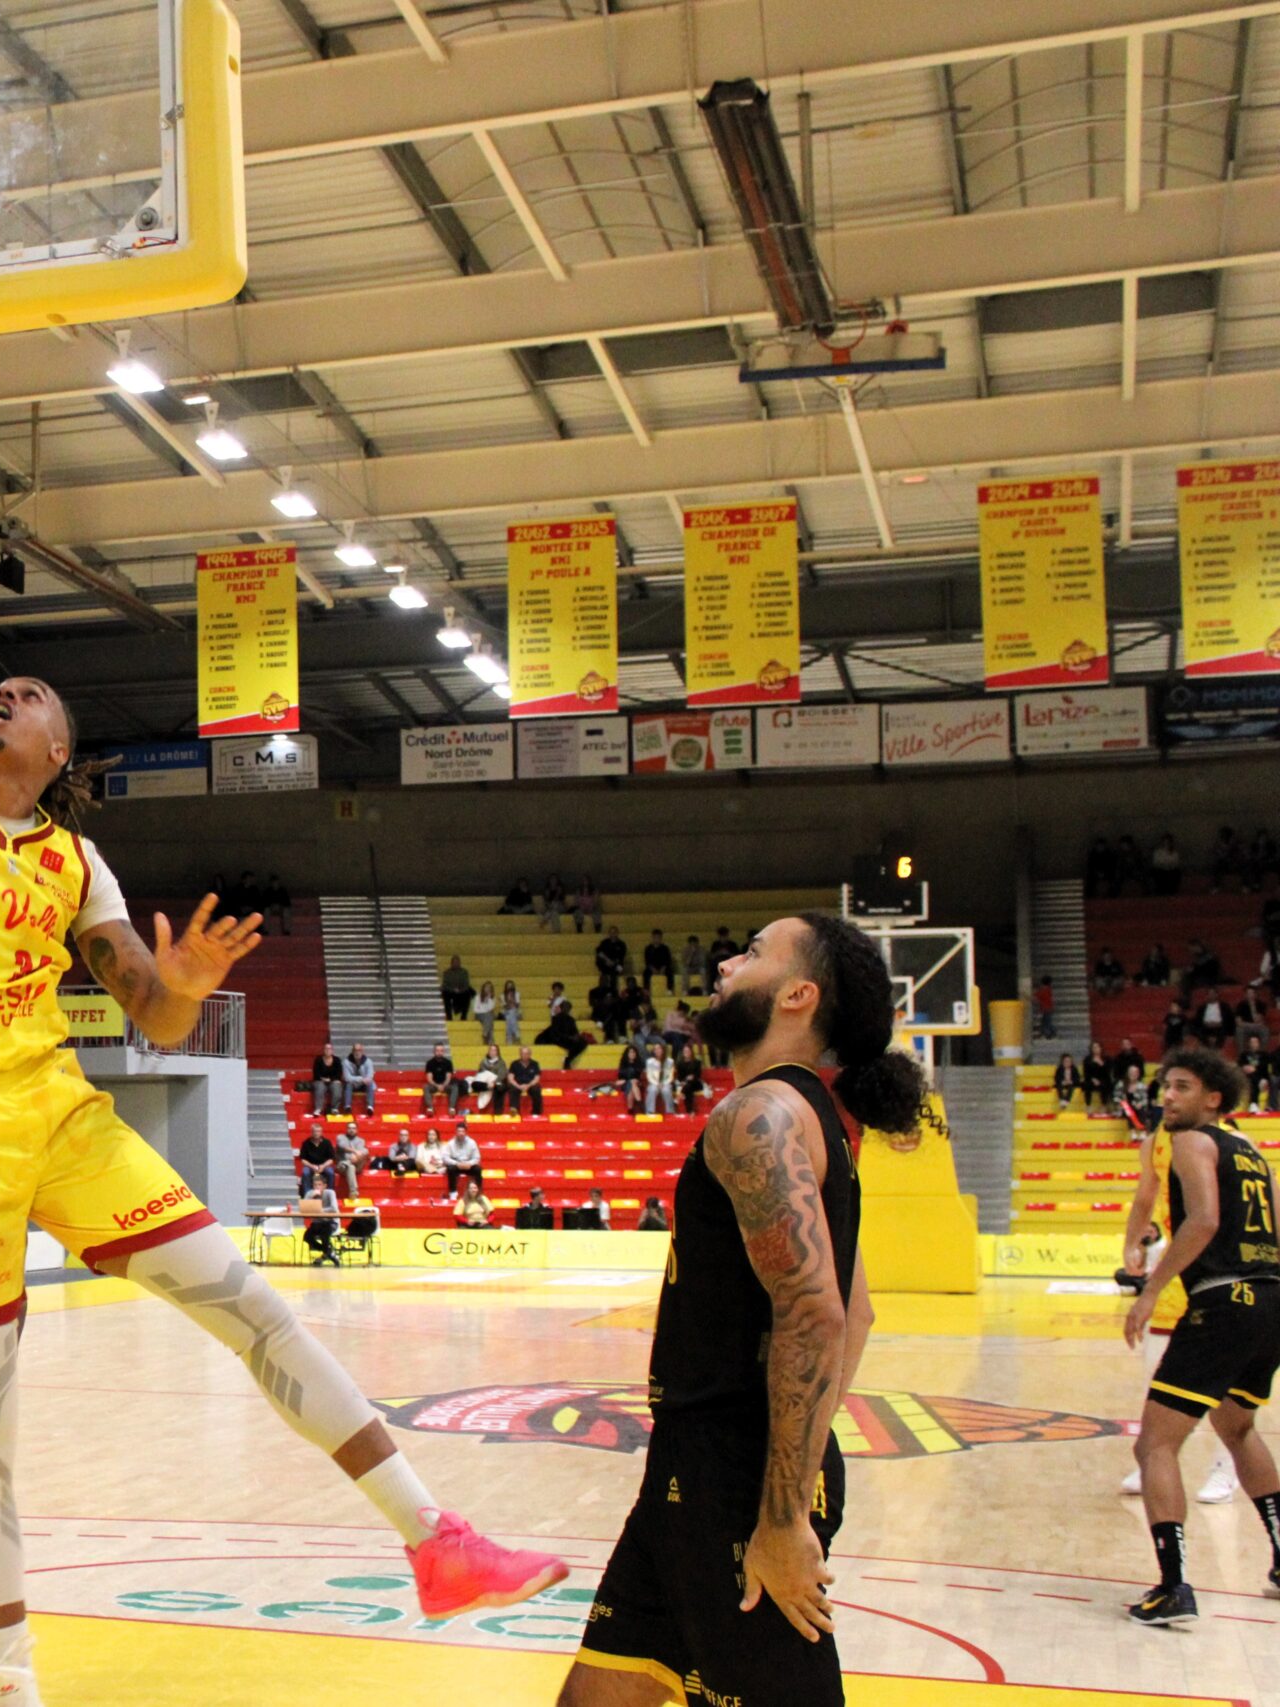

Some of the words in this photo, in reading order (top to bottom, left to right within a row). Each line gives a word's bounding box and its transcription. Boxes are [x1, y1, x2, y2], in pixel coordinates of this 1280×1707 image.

[701, 528, 760, 541] CHAMPION
[762, 526, 777, 538] DE
[717, 540, 762, 553] FRANCE
[212, 569, 263, 583] CHAMPION
[266, 567, 279, 578] DE
[226, 580, 266, 593] FRANCE
[405, 730, 445, 748] Crédit
[463, 730, 509, 744] Mutuel
[885, 734, 927, 762] Ville
[931, 711, 1005, 751] Sportive
[144, 753, 157, 763] LA
[425, 747, 453, 759] Nord
[455, 746, 494, 758] Drôme
[897, 856, 912, 878] 6
[112, 1184, 192, 1231] koesio
[1230, 1281, 1255, 1307] 25
